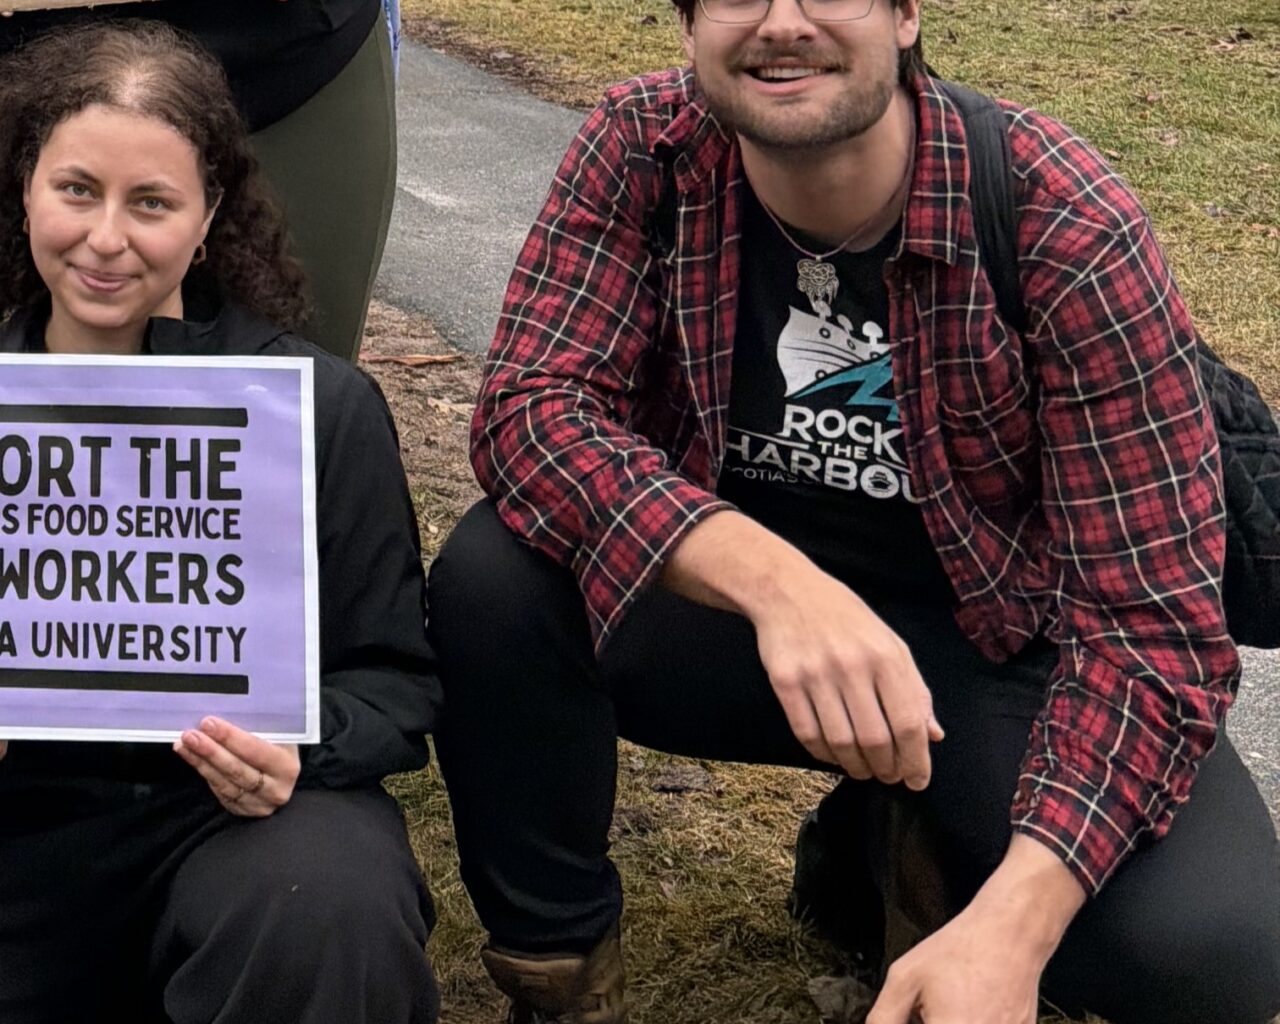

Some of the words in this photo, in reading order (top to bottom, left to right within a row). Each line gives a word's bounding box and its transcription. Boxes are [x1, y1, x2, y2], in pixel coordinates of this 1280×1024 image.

[776, 403, 908, 466] ROCK
[816, 440, 869, 460] THE
[130, 436, 243, 501] THE
[26, 502, 109, 537] FOOD
[115, 505, 242, 540] SERVICE
[31, 621, 248, 664] UNIVERSITY
